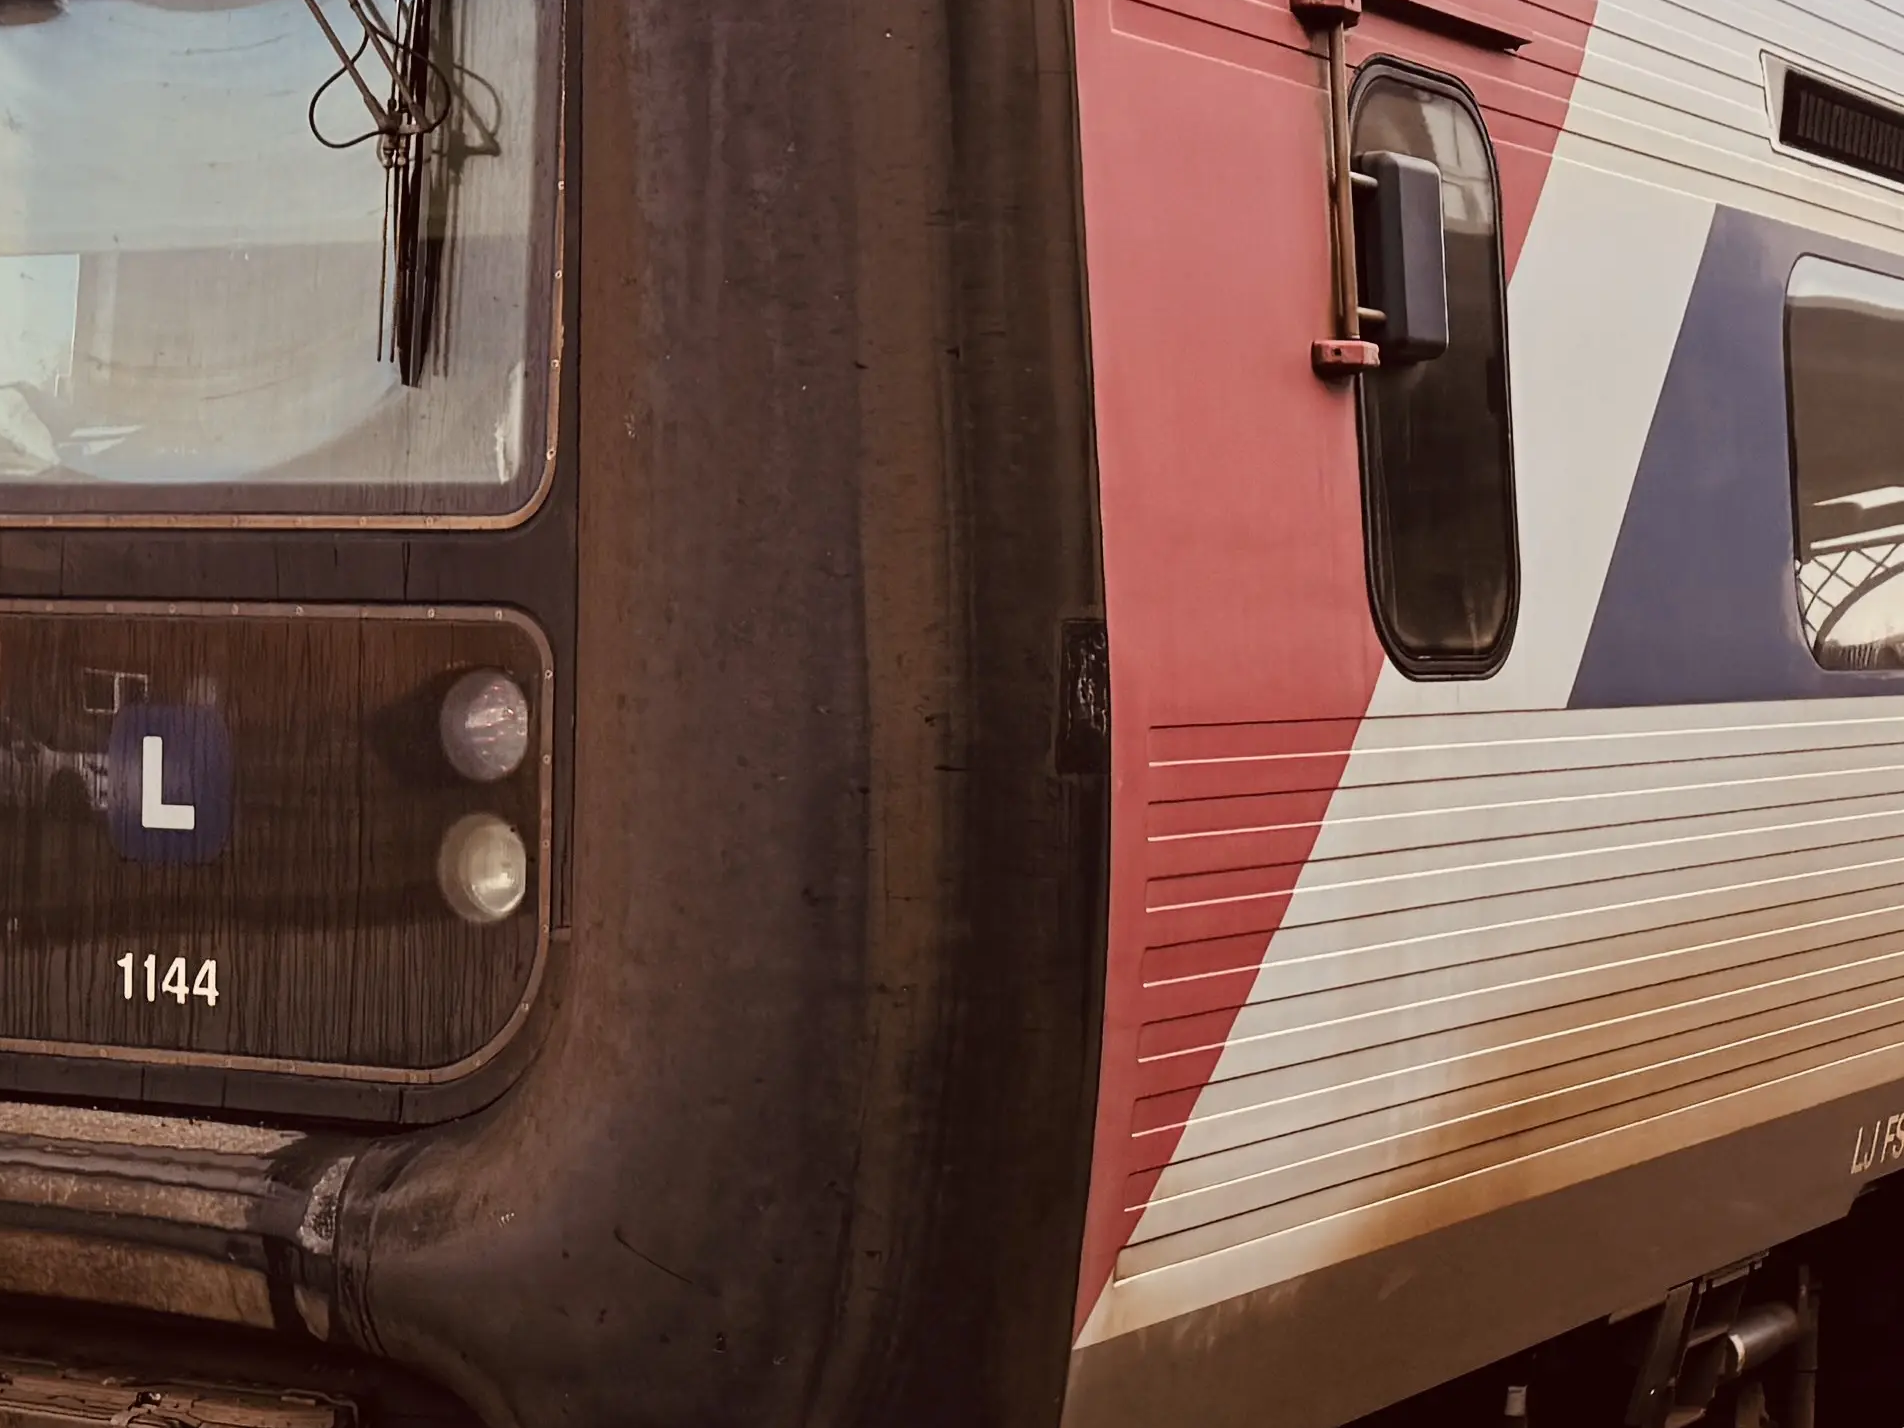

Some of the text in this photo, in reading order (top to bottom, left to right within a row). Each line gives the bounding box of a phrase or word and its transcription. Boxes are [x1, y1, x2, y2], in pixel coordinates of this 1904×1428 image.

[141, 735, 196, 831] L
[116, 952, 220, 1006] 1144
[1850, 1119, 1881, 1175] LJ
